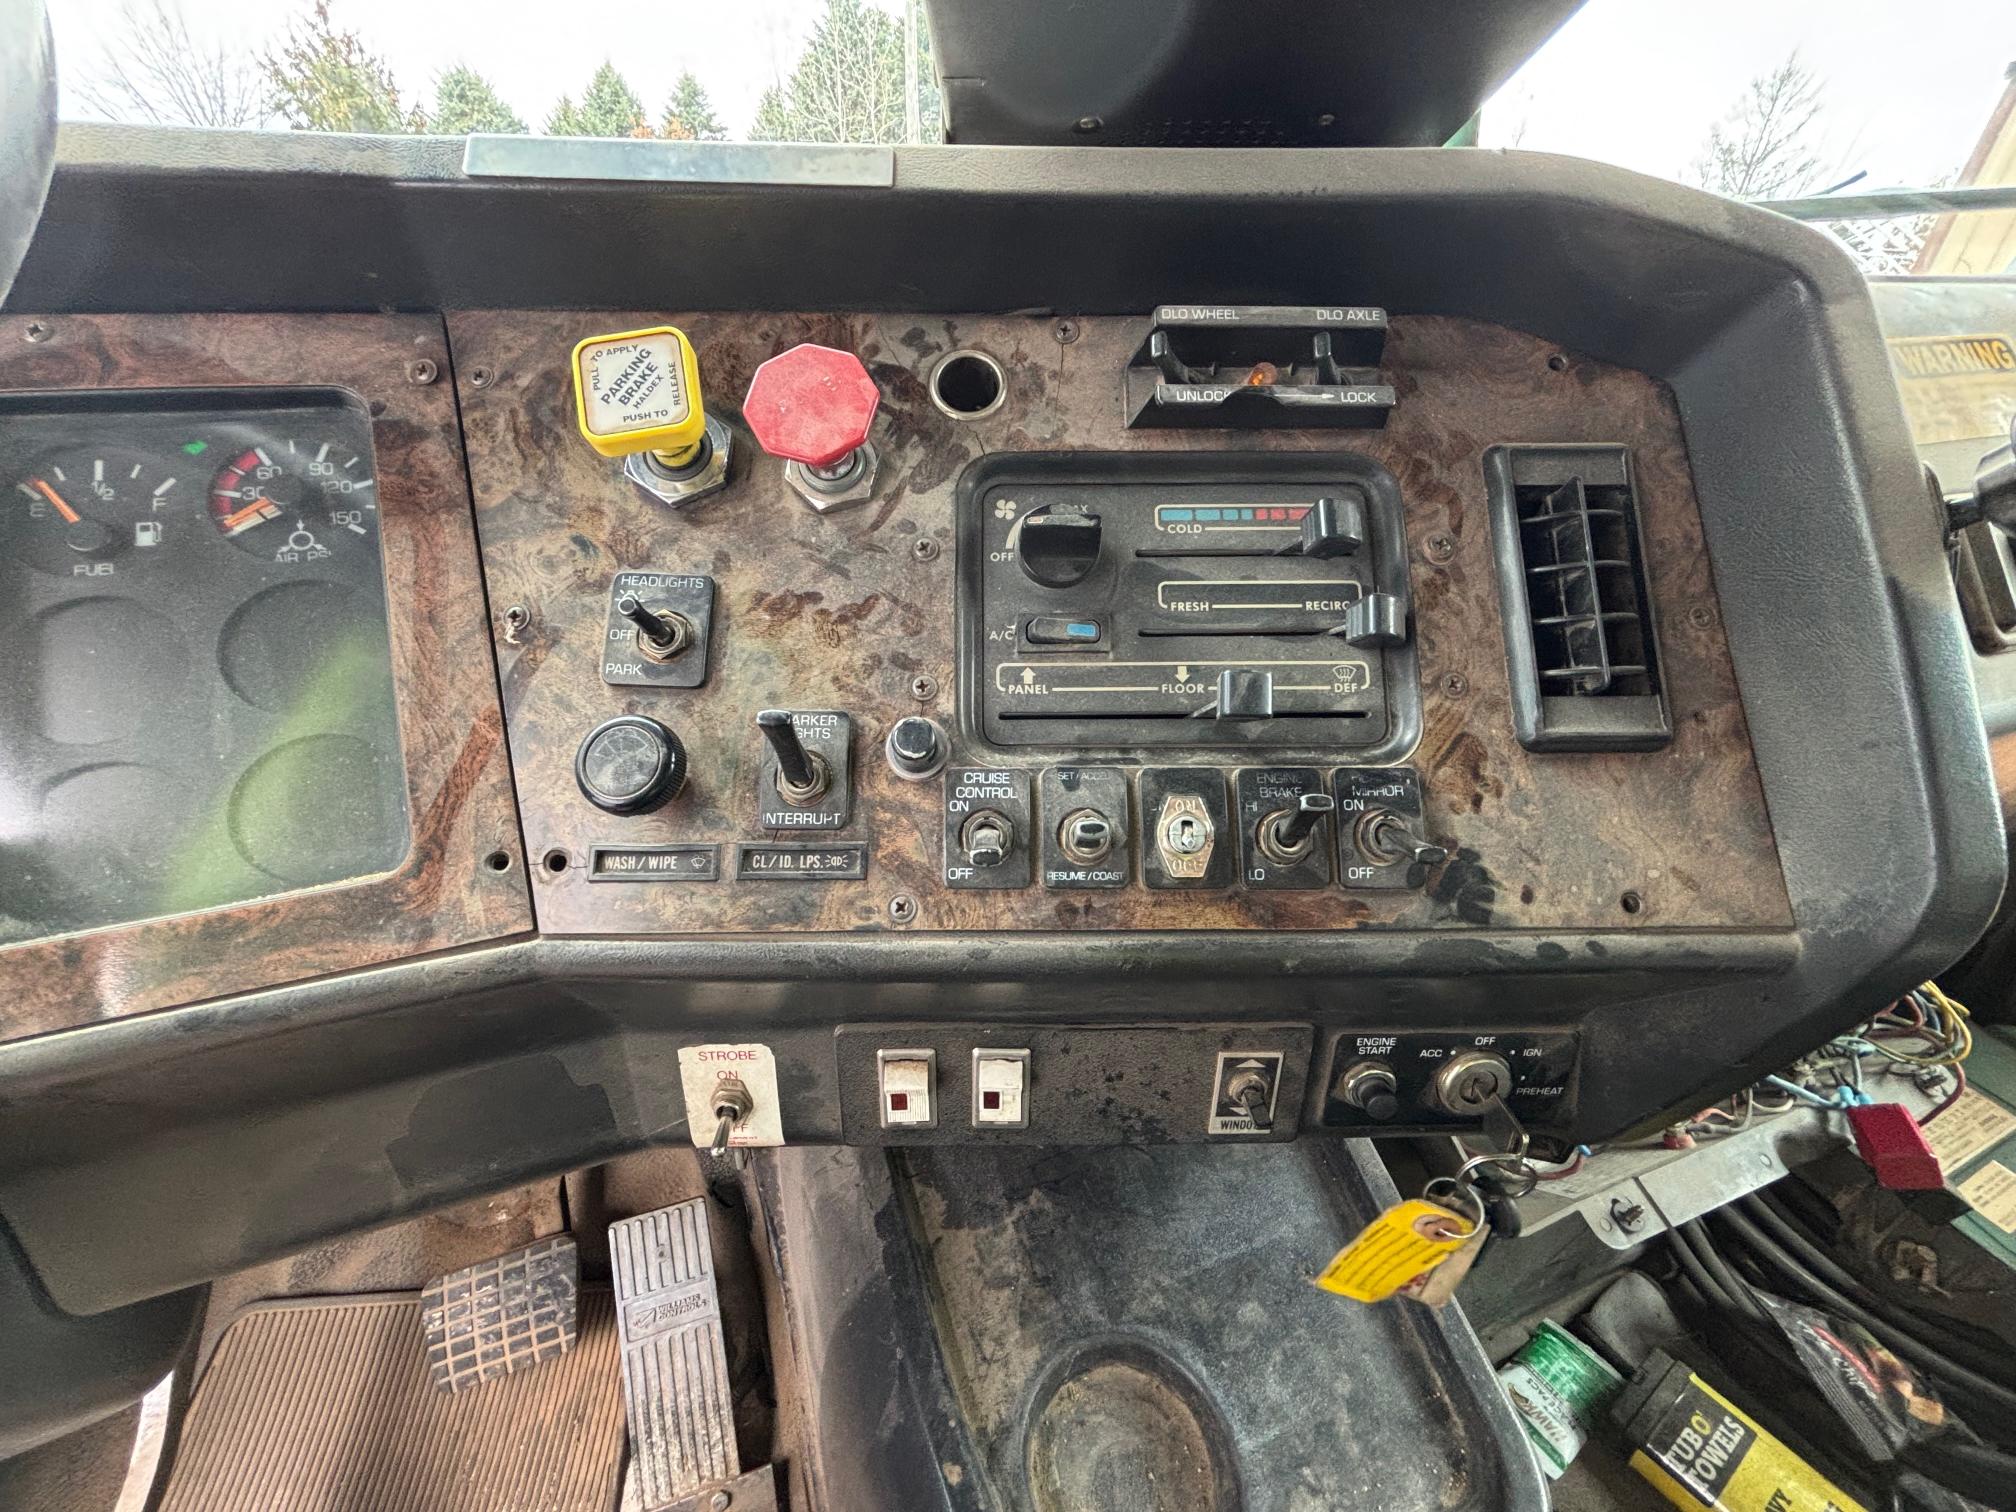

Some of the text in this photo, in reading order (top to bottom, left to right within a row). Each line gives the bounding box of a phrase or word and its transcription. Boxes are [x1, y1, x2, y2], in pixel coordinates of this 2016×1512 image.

[1191, 309, 1240, 320] WHEEL
[1347, 310, 1381, 321] AXLE
[591, 344, 638, 390] PULL TO APPLY
[600, 348, 652, 405] PARKING
[618, 362, 658, 406] BRAKE
[623, 361, 680, 422] PUSH TO RELEASE
[632, 374, 664, 409] HALDEX
[1340, 391, 1376, 403] LOCK
[308, 462, 334, 476] 90
[321, 480, 353, 493] 120
[152, 497, 167, 512] F
[329, 510, 362, 524] 150
[1167, 524, 1202, 534] COLD
[990, 552, 1015, 562] OFF
[621, 576, 704, 589] HEADLIGHTS
[1170, 602, 1209, 611] FRESH
[609, 629, 633, 641] OFF
[989, 630, 1014, 641] A/C
[605, 663, 642, 675] PARK
[1008, 684, 1048, 695] PANEL
[1161, 684, 1204, 695] FLOOR
[1334, 683, 1358, 693] DEF
[791, 714, 838, 727] ARKER
[796, 727, 831, 739] GHTS
[963, 772, 1010, 784] CRUISE
[955, 786, 1019, 799] CONTROL
[1260, 786, 1303, 798] BRAKE
[949, 800, 969, 812] ON
[1245, 801, 1258, 812] HI
[1343, 799, 1364, 811] ON
[762, 812, 841, 825] INTERRUPT
[948, 867, 974, 880] OFF
[1248, 868, 1265, 880] LO
[1348, 867, 1374, 879] OFF
[1356, 1037, 1397, 1046] ENGINE
[1474, 1036, 1496, 1046] OFF
[698, 1051, 758, 1062] STROBE
[1358, 1046, 1392, 1055] START
[1419, 1049, 1443, 1058] ACC
[1523, 1048, 1542, 1057] IGN
[717, 1071, 738, 1081] ON
[1516, 1087, 1564, 1096] PREHEAT
[1220, 1120, 1257, 1130] WINDO
[1665, 1427, 1703, 1474] TUB
[1686, 1415, 1745, 1490] TOWELS
